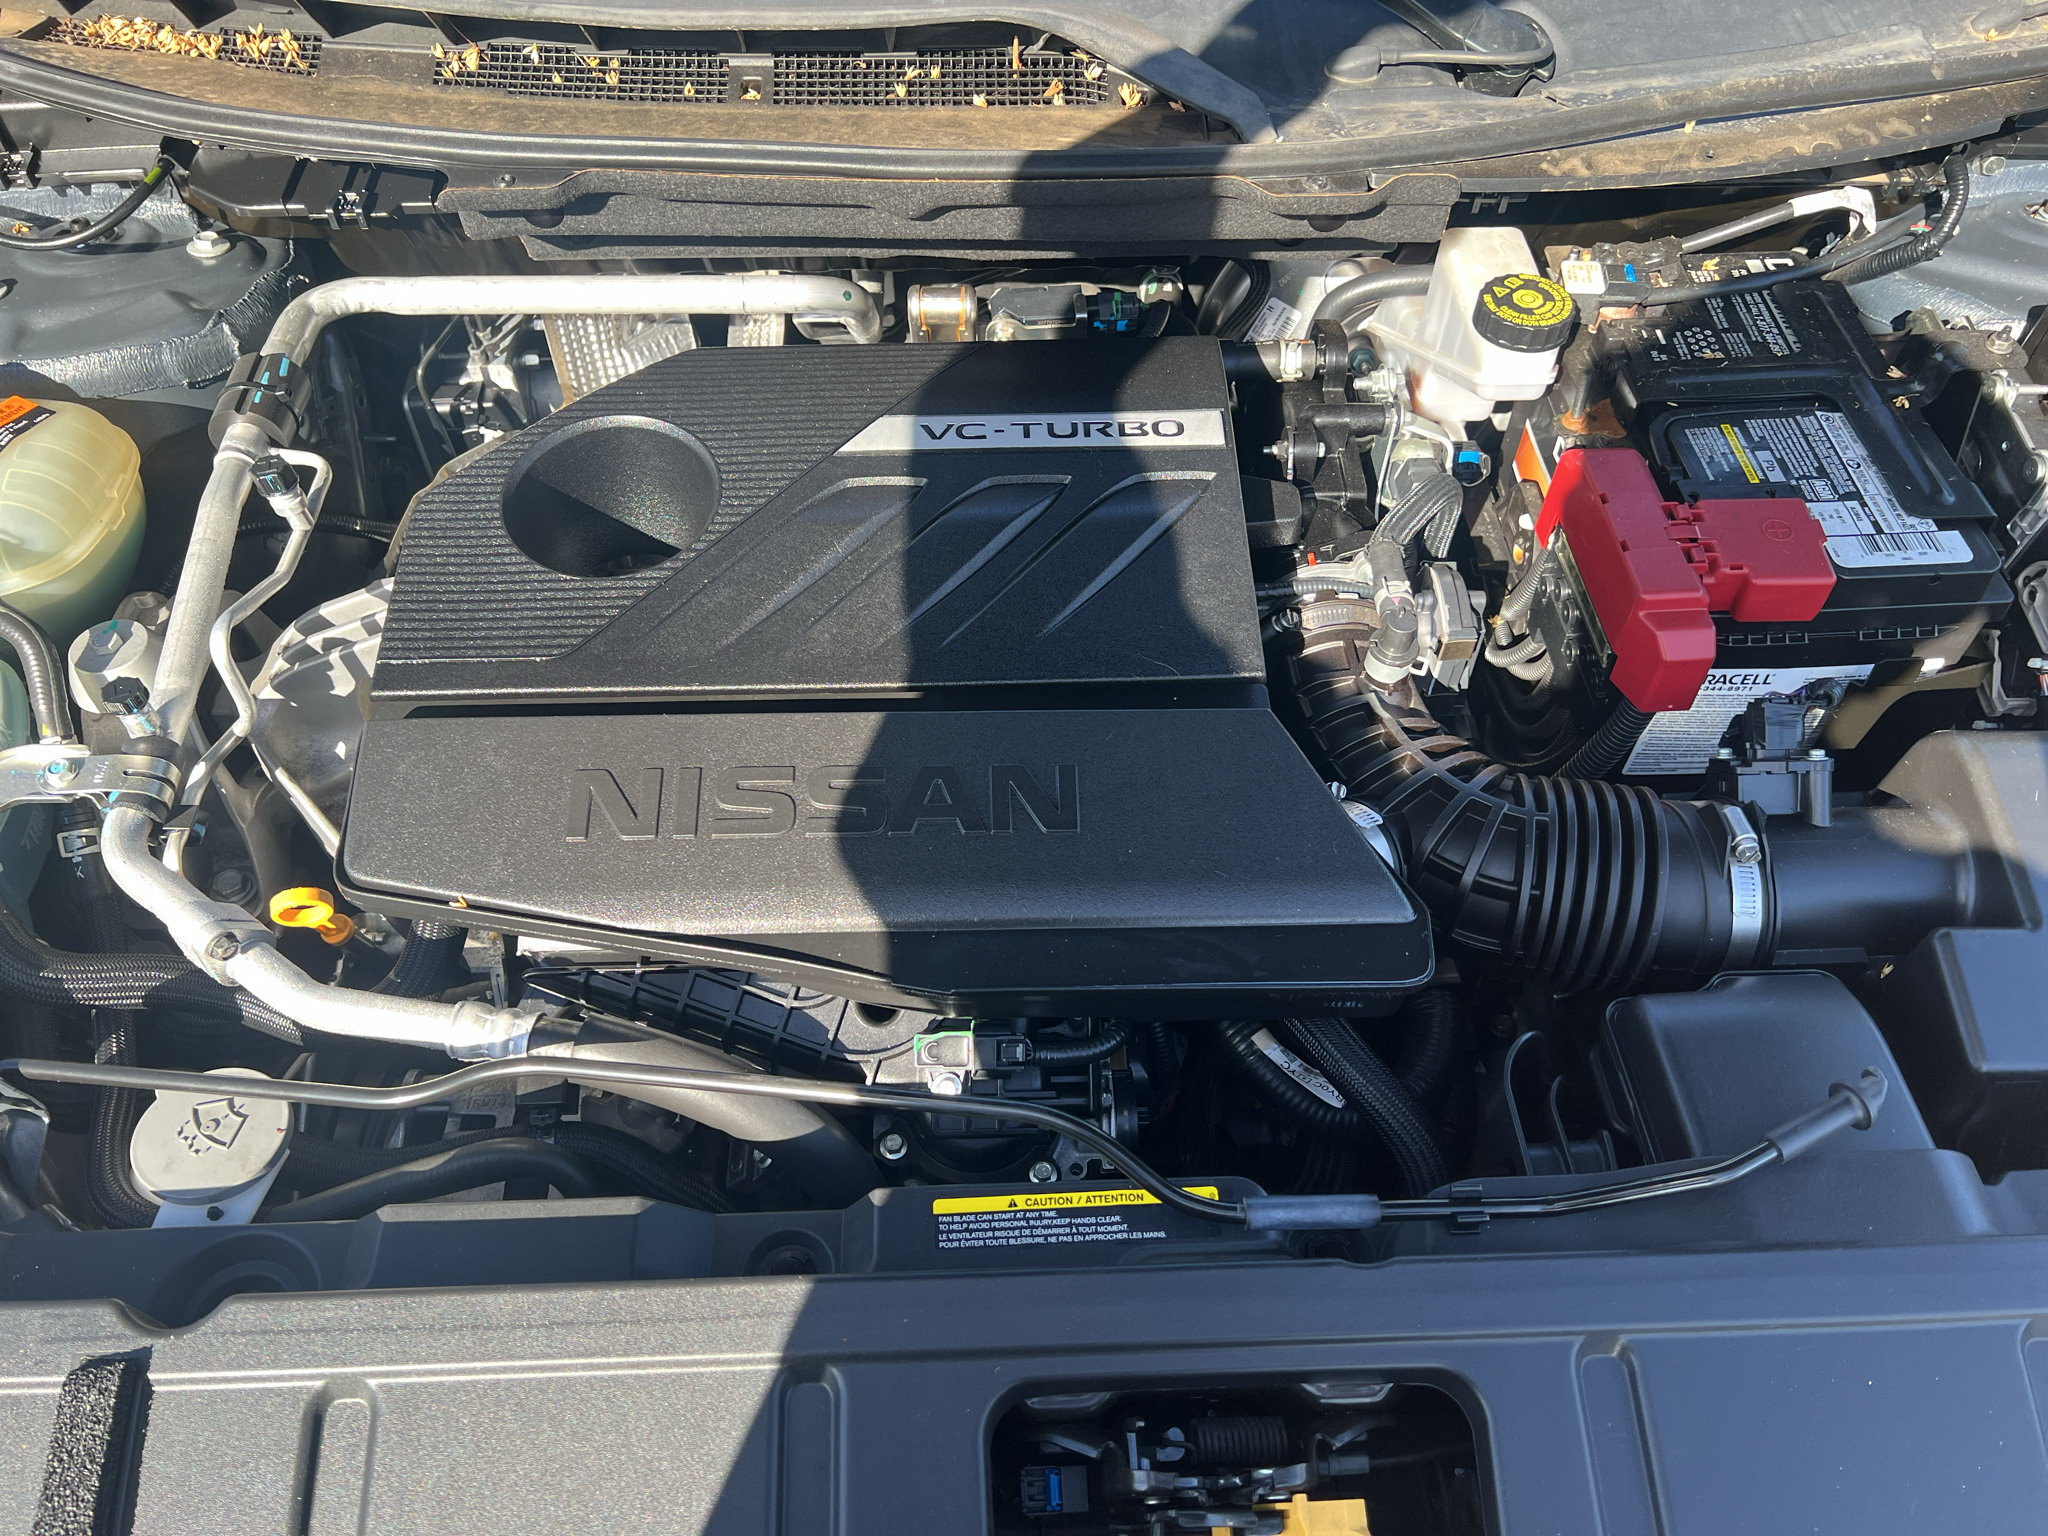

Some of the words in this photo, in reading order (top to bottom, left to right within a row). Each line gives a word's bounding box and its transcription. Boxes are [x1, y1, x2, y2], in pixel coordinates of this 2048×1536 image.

[1500, 306, 1520, 318] CLEAN
[1512, 317, 1523, 325] OR
[919, 419, 1185, 441] VC-TURBO
[1762, 459, 1775, 472] Pb
[1814, 480, 1835, 500] AGM
[1702, 674, 1772, 685] RACELL
[565, 763, 1080, 842] NISSAN
[1025, 1196, 1073, 1207] CAUTION
[1085, 1193, 1144, 1204] ATTENTION
[950, 1222, 968, 1230] HELP
[968, 1222, 990, 1230] AVOID
[991, 1219, 1028, 1228] PERSONAL
[1097, 1215, 1122, 1223] CLEAR.
[953, 1214, 976, 1222] BLADE
[994, 1212, 1014, 1220] START
[1041, 1210, 1058, 1218] TIME.
[948, 1230, 993, 1240] VENTILATEUR
[994, 1229, 1020, 1238] RISQUE
[1022, 1228, 1032, 1236] DE
[1032, 1226, 1070, 1236] DÉMARRER
[1078, 1226, 1096, 1234] TOUT
[1097, 1224, 1128, 1232] MOMENT.
[960, 1239, 984, 1248] ÉVITER
[985, 1238, 1007, 1246] TOUTE
[1074, 1234, 1084, 1242] EN
[1084, 1232, 1128, 1241] APPROCHER
[1143, 1230, 1166, 1238] MAINS.
